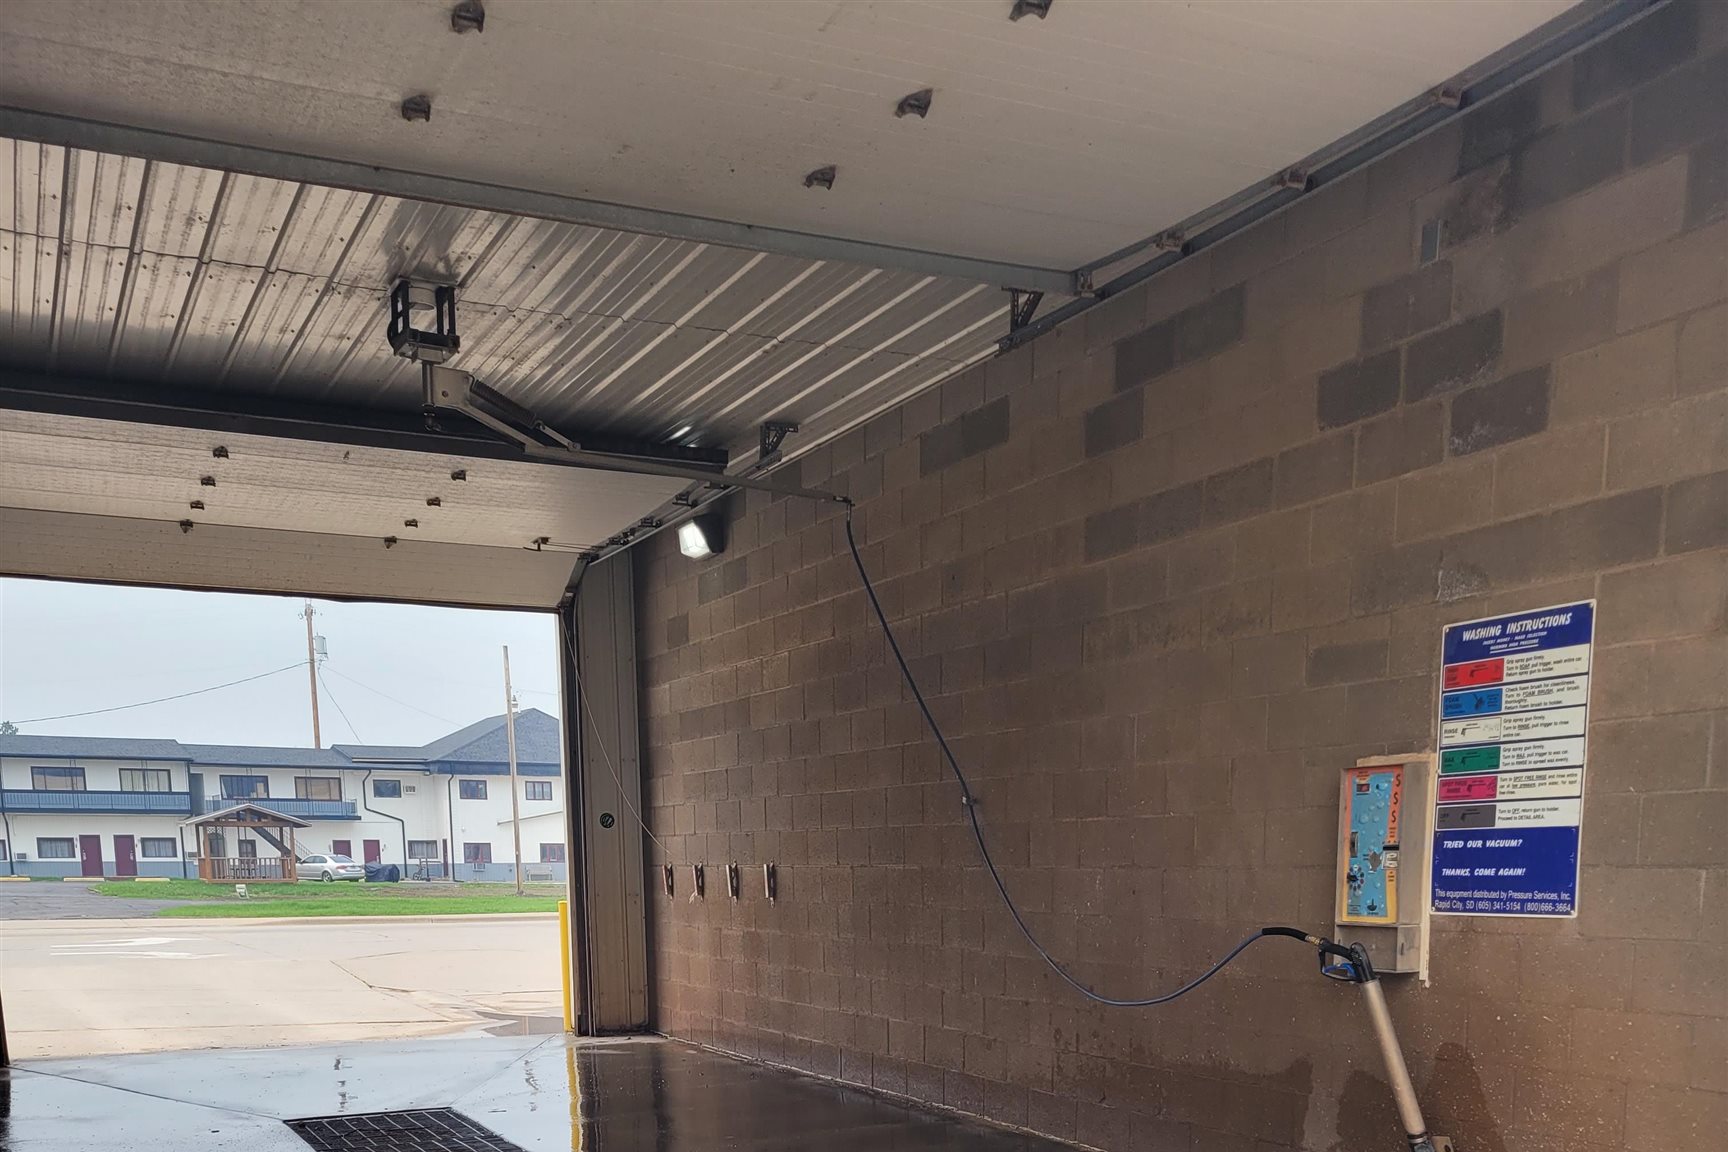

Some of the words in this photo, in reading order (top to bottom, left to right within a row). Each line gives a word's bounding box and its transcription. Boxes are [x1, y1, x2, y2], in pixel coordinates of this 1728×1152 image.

[1462, 625, 1502, 641] WASHING
[1506, 613, 1572, 634] INSTRUCTIONS
[1500, 890, 1507, 900] by
[1508, 890, 1532, 899] Pressure
[1534, 891, 1559, 900] Services,
[1561, 891, 1571, 900] Inc.
[1435, 900, 1450, 909] Rapid
[1476, 901, 1491, 911] (605)
[1493, 902, 1520, 910] 341-5154
